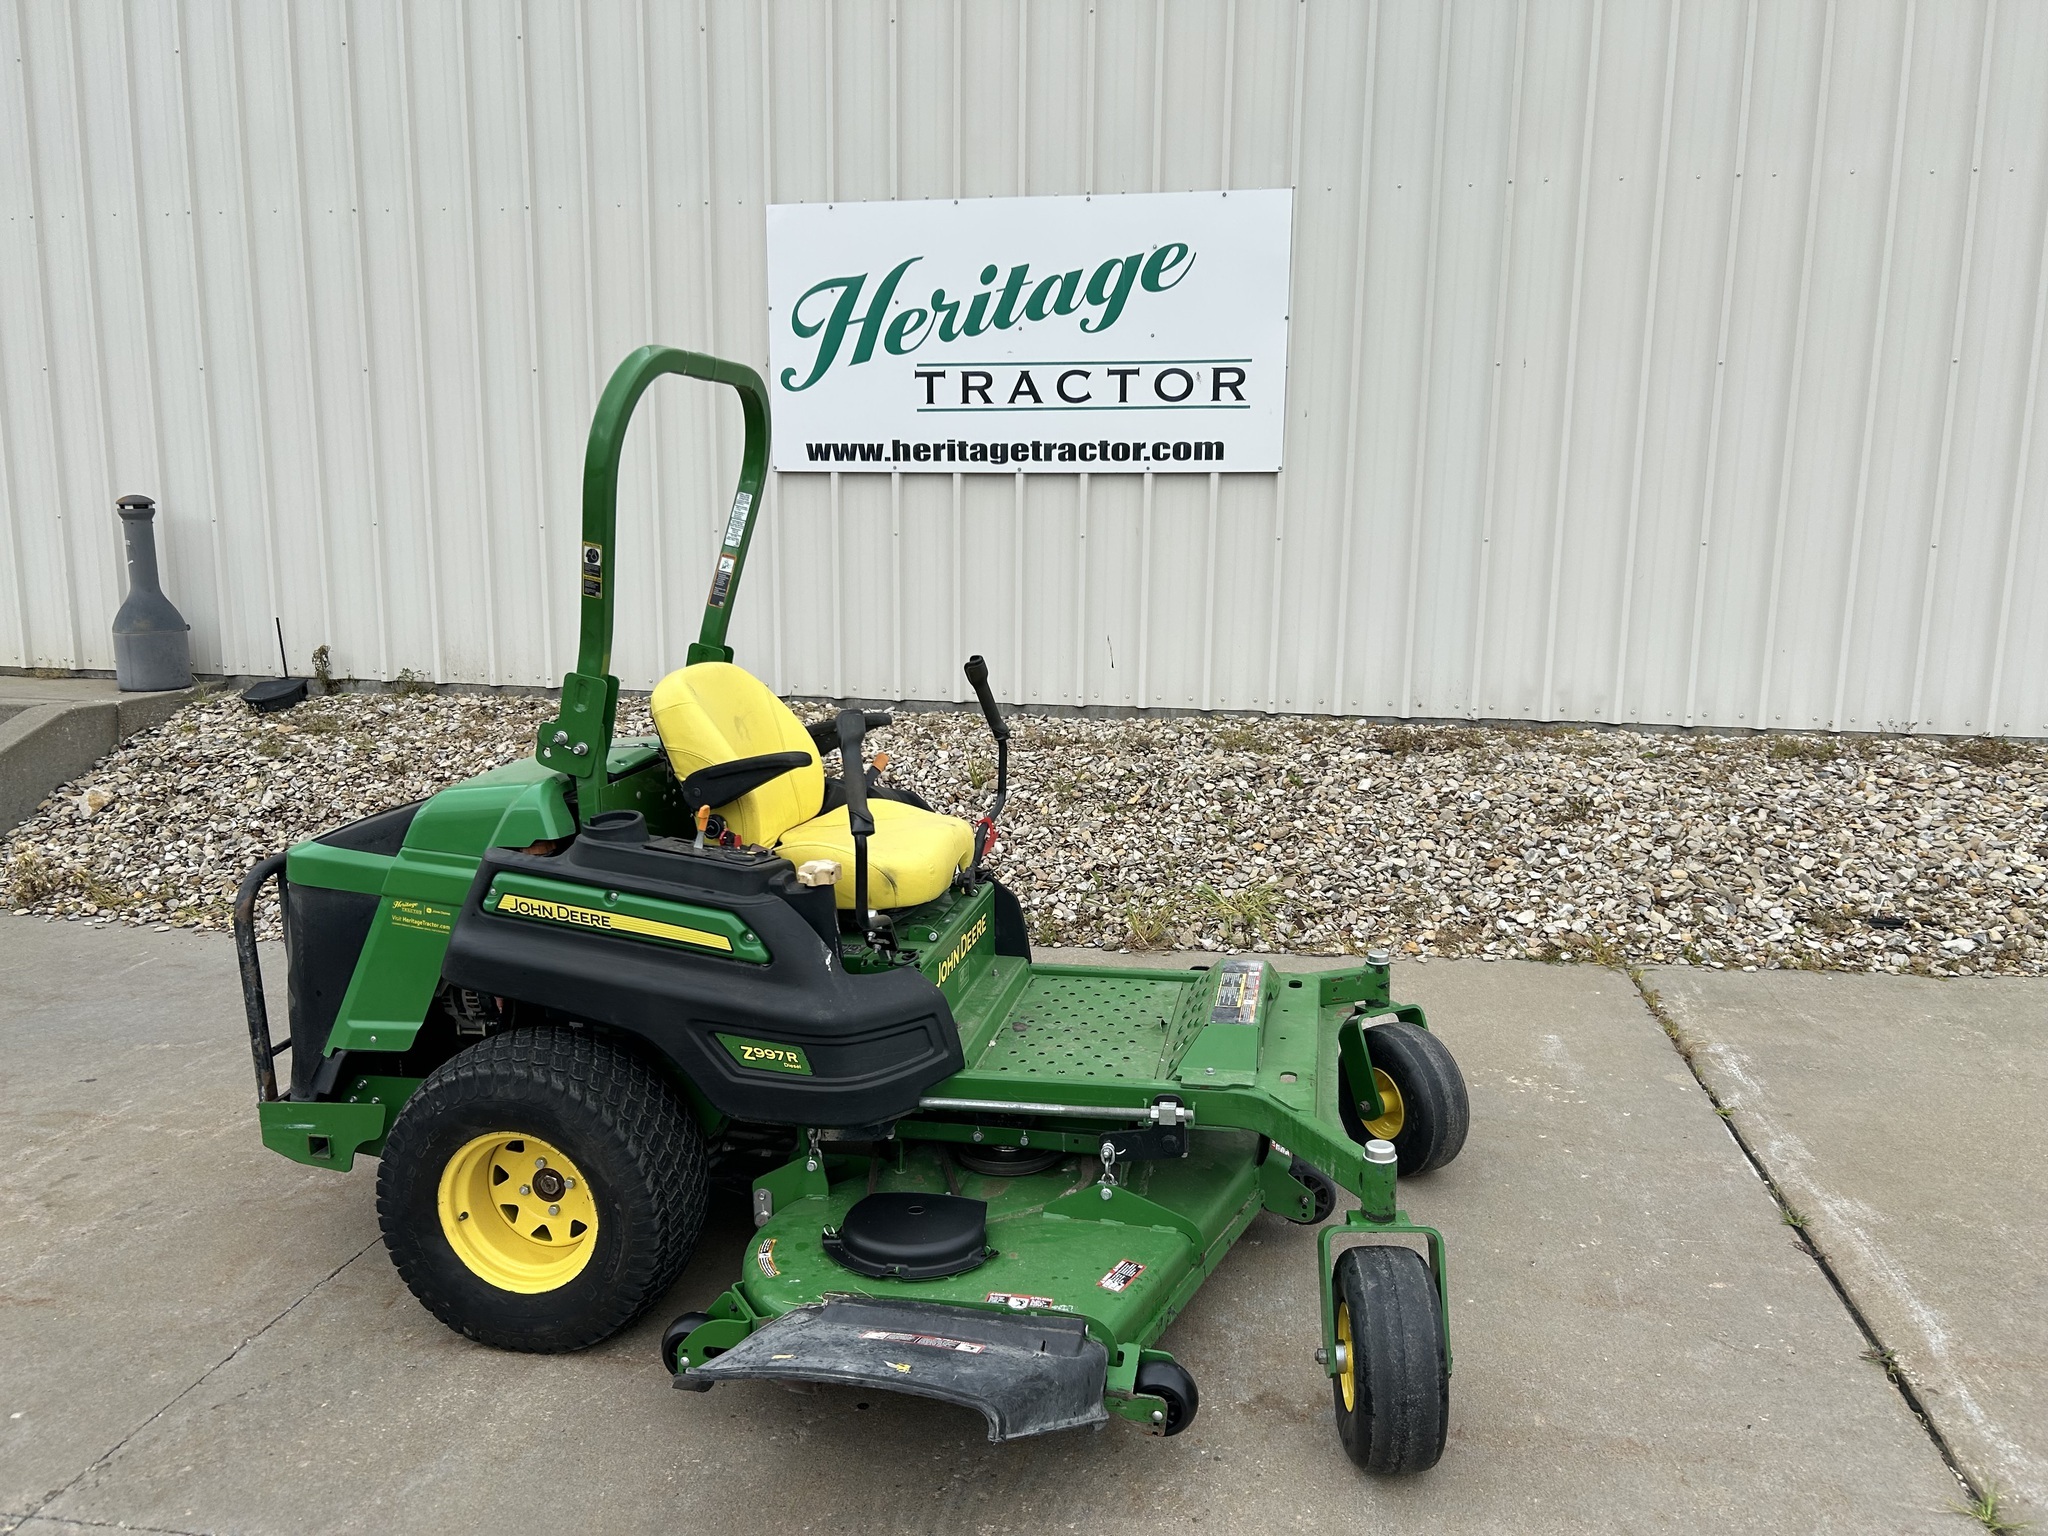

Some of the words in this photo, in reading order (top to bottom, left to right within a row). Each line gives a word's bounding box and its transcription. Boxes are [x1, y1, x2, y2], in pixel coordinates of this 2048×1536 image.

[781, 242, 1197, 392] Heritage
[914, 366, 1246, 405] TRACTOR
[806, 437, 1225, 465] www.heritagetractor.com
[402, 916, 451, 930] HeritageTractor.com
[509, 898, 553, 918] JOHN
[557, 905, 612, 928] DEERE
[935, 944, 960, 988] JOHN
[960, 912, 987, 960] DEERE
[740, 1045, 799, 1063] Z997R
